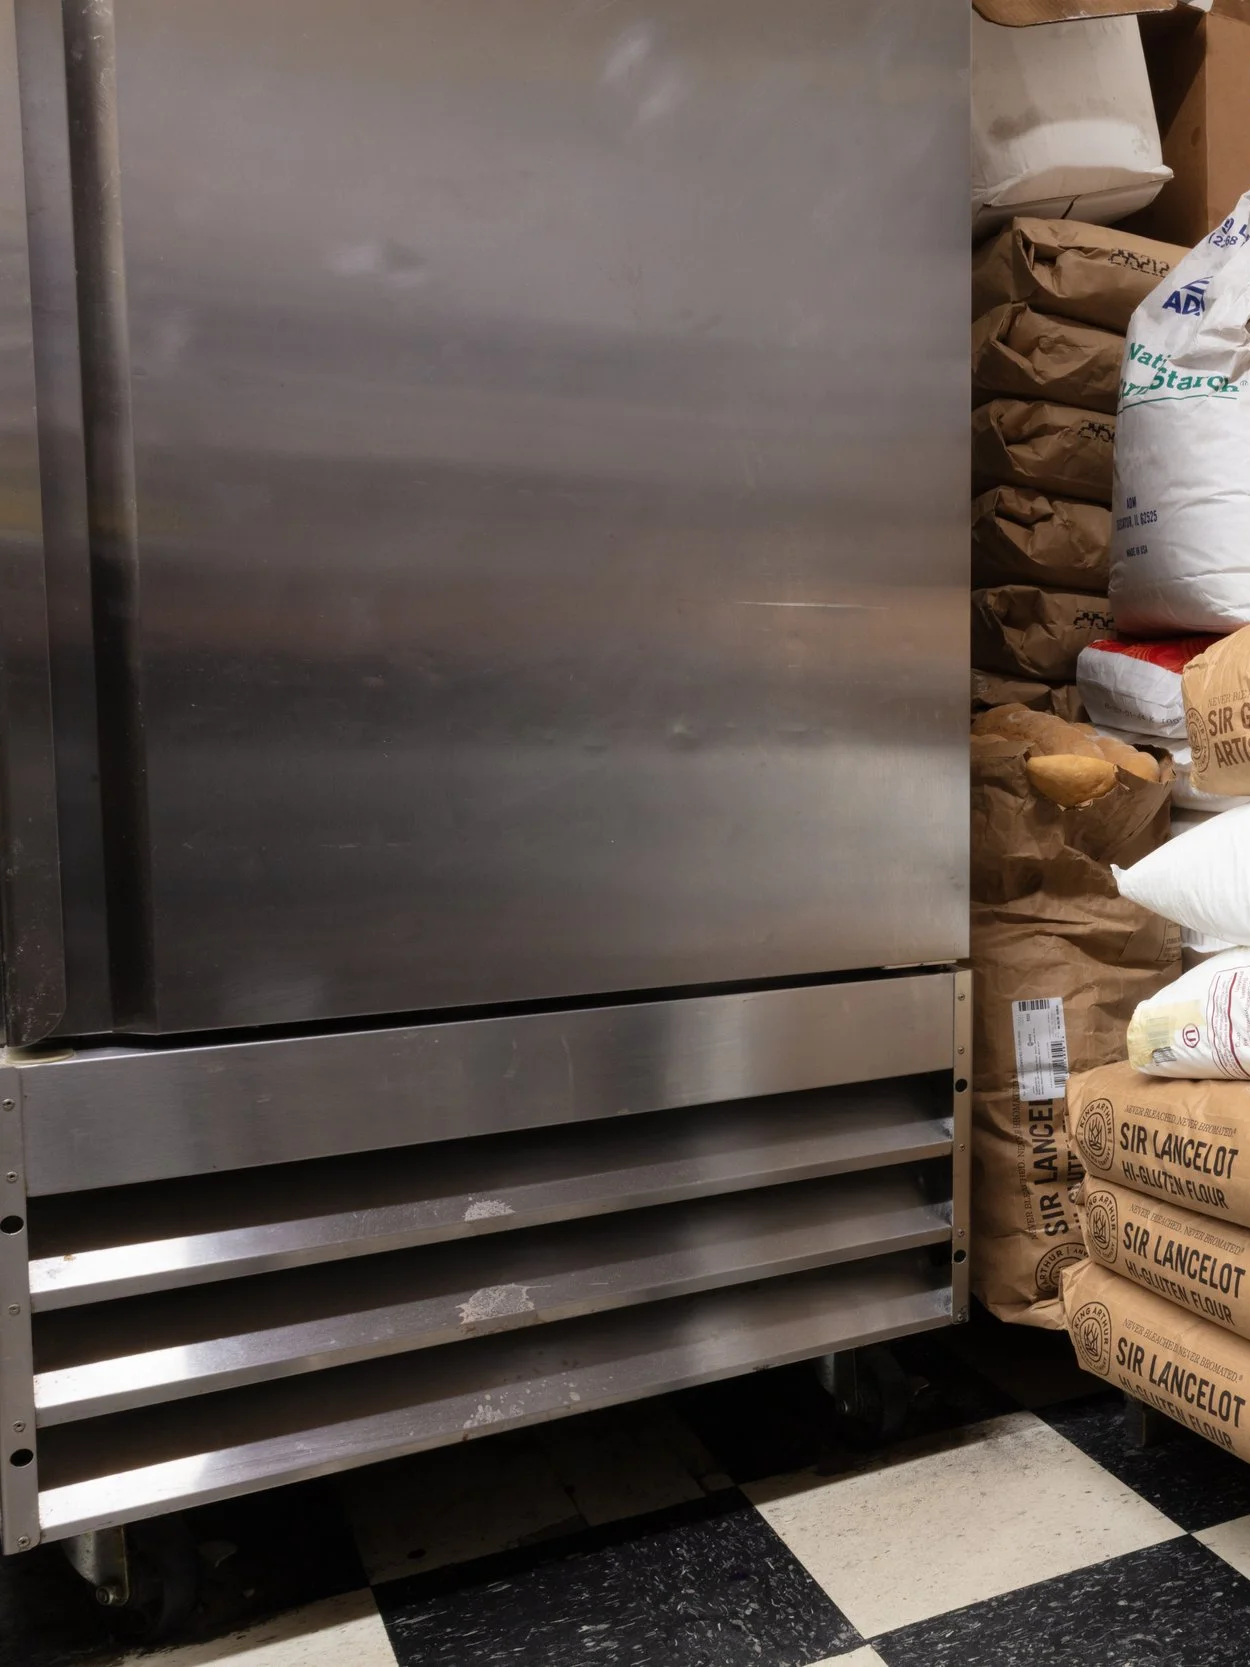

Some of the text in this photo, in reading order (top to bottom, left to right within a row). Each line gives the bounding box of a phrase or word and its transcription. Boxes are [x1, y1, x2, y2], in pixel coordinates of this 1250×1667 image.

[1162, 290, 1205, 316] AD
[1140, 510, 1158, 526] 62525
[1207, 706, 1234, 737] SIR
[1080, 1104, 1095, 1128] KING
[1096, 1102, 1112, 1134] ARTHUR
[1124, 1104, 1144, 1116] NEVER
[1177, 1114, 1199, 1129] NEVER
[1029, 1098, 1058, 1186] LANCEL
[1119, 1122, 1239, 1179] SIR LANCELOT
[1122, 1160, 1186, 1198] HI-GLUTEN
[1185, 1179, 1230, 1210] FLOUR
[1039, 1192, 1069, 1237] SIR
[1098, 1194, 1116, 1230] ARTHUR
[1129, 1203, 1151, 1220] NEVER
[1183, 1226, 1204, 1242] NEVER
[1123, 1221, 1246, 1298] SIR LANCELOT
[1124, 1258, 1236, 1326] HI-GLUTEN FLOUR
[1074, 1306, 1109, 1345] KING ARTHUR
[1123, 1318, 1144, 1335] NEVER
[1178, 1345, 1200, 1364] NEVER
[1115, 1336, 1145, 1377] SIR
[1148, 1354, 1246, 1429] LANCELOT
[1188, 1412, 1237, 1452] FLOUR
